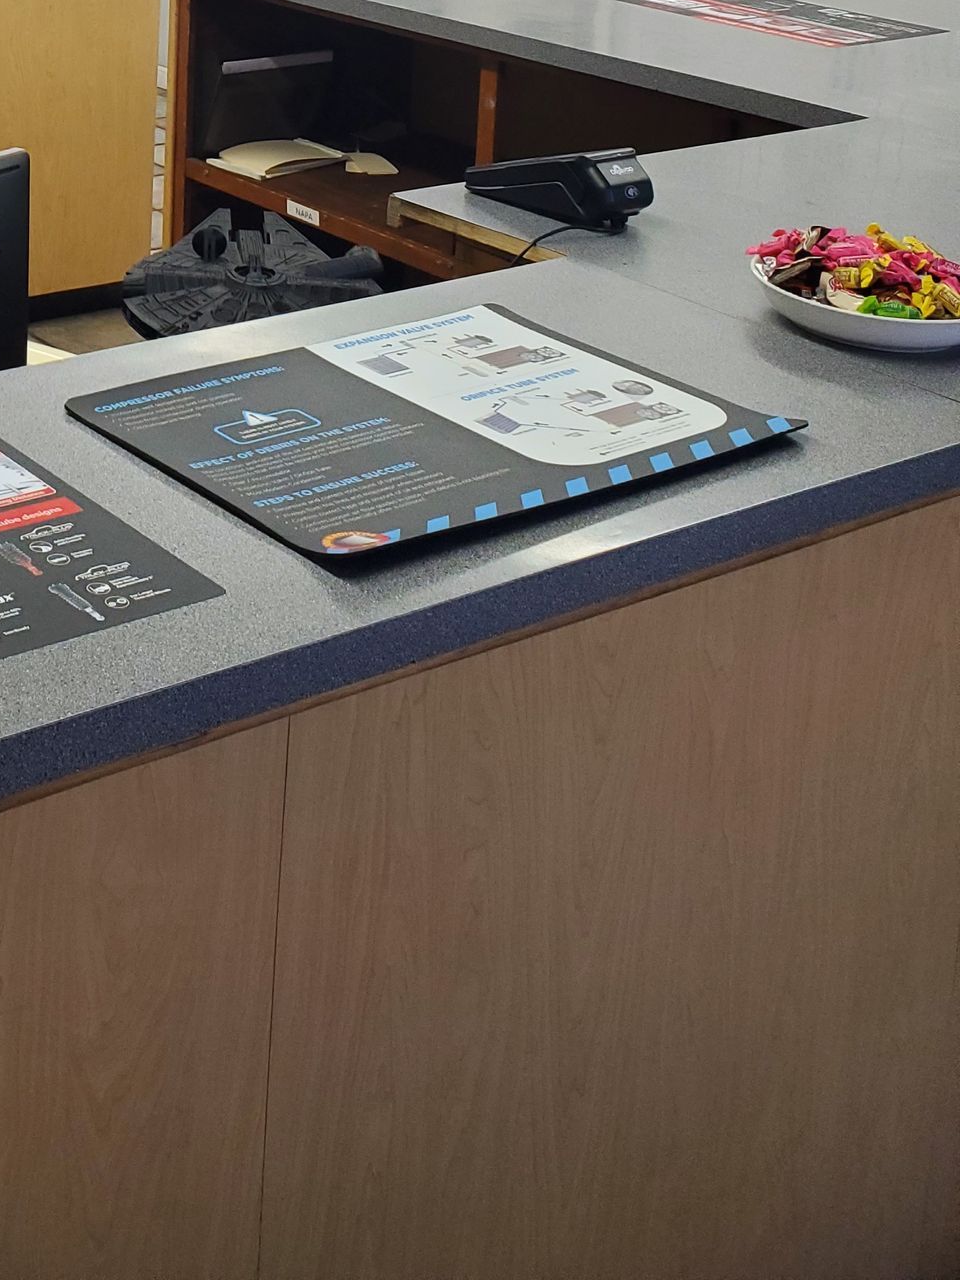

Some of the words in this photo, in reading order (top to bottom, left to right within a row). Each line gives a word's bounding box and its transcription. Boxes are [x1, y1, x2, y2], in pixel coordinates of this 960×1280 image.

[294, 207, 313, 221] NAPA
[334, 331, 398, 350] EXPANSION
[399, 323, 433, 338] VALVE
[434, 314, 474, 328] SYSTEM
[95, 390, 174, 413] COMPRESSOR
[174, 379, 222, 395] FAILURE
[460, 387, 504, 402] ORIFICE
[504, 378, 537, 393] TUBE
[537, 368, 580, 383] SYSTEM
[189, 455, 236, 470] EFFECT
[237, 449, 255, 460] OF
[258, 440, 299, 455] DEBRIS
[300, 434, 317, 444] ON
[318, 427, 342, 440] THE
[253, 494, 293, 508] STEPS
[295, 488, 312, 498] TO
[312, 476, 360, 494] ENSURE
[360, 460, 419, 480] SUCCESS:
[22, 507, 63, 520] designs
